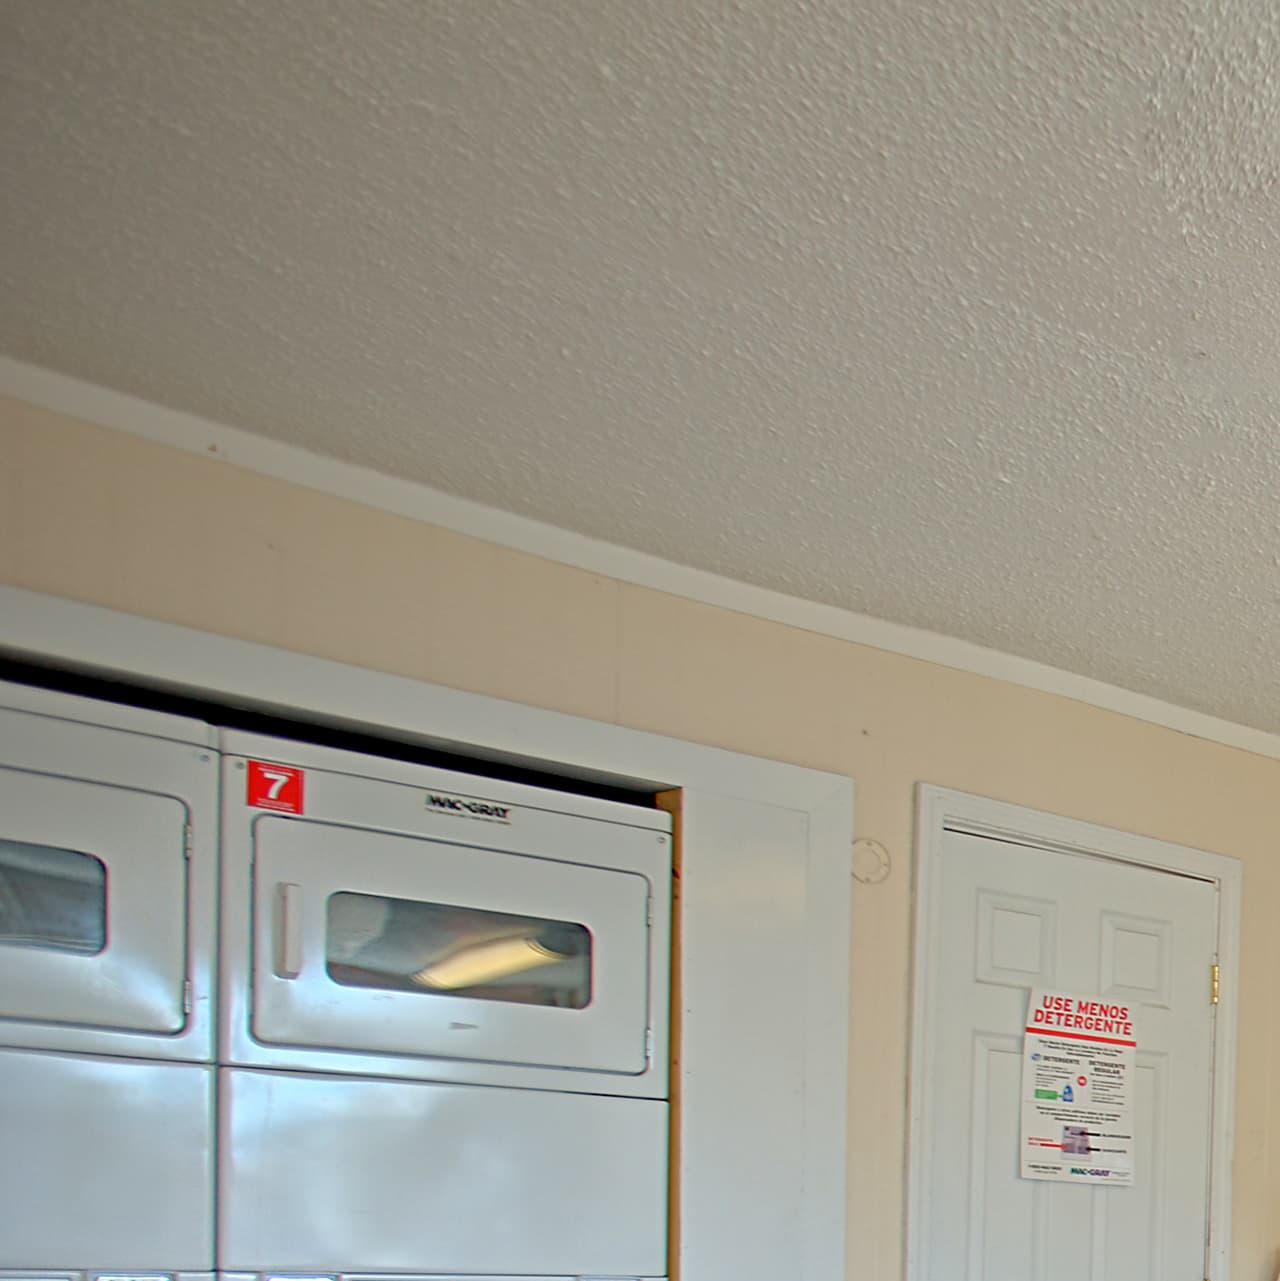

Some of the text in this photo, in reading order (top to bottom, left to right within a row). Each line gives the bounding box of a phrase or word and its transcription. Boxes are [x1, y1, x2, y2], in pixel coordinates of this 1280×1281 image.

[263, 771, 289, 800] 7
[1042, 995, 1129, 1020] USE MENOS
[1033, 1008, 1132, 1036] DETERGENTE
